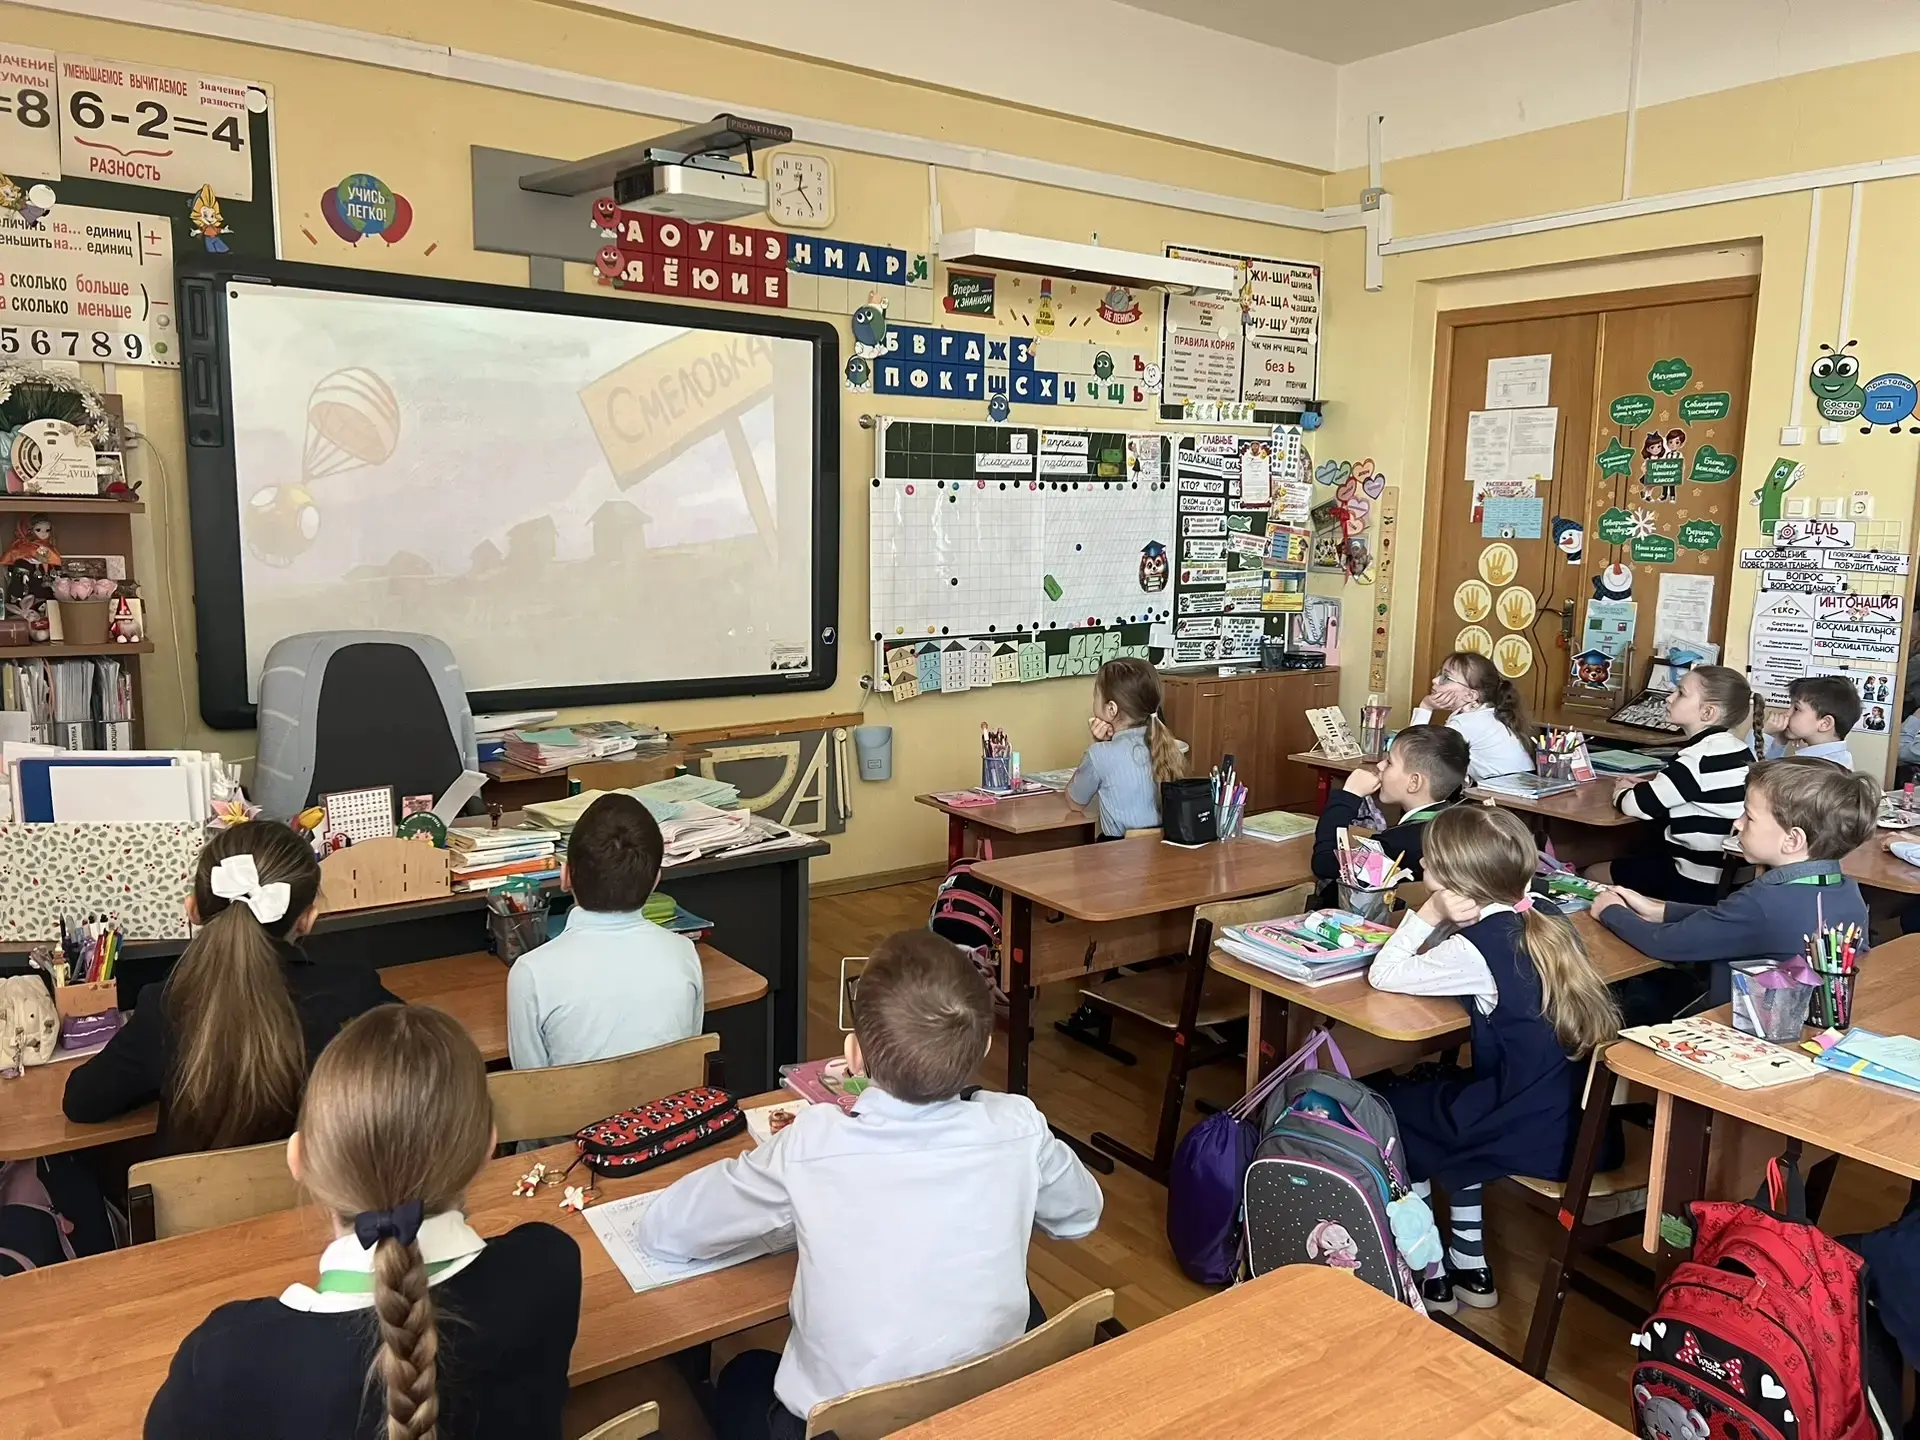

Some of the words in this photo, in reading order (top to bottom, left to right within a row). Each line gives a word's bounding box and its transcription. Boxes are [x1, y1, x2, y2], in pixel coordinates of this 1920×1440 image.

[63, 63, 124, 87] УМЕНЬШАЕМОЕ
[129, 73, 188, 97] ВЫЧИТАЕМОЕ
[198, 80, 246, 97] Значение
[199, 95, 246, 111] разности
[730, 119, 791, 138] PROMETHEAN
[89, 156, 161, 182] РАЗНОСТЬ
[347, 186, 385, 205] УЧИСЬ
[347, 203, 387, 222] ЛЕГКО!
[86, 225, 132, 241] единиц
[87, 241, 133, 258] единиц
[626, 220, 644, 244] А
[660, 224, 681, 247] О
[698, 229, 714, 252] У
[728, 233, 753, 257] Ы
[765, 237, 781, 260] Э
[795, 243, 811, 265] Н
[824, 247, 843, 269] М
[886, 255, 900, 275] Р
[626, 260, 644, 283] Я
[663, 258, 679, 288] Ё
[692, 267, 720, 291] Ю
[731, 272, 749, 295] И
[765, 276, 780, 299] Е
[1250, 269, 1289, 284] ЖИ-ШИ
[1290, 270, 1312, 279] лыжи
[10, 273, 67, 291] сколько
[76, 274, 129, 297] больше
[1291, 281, 1312, 290] шина
[12, 296, 69, 315] сколько
[78, 301, 132, 319] меньше
[1252, 294, 1289, 309] ЧА-ЩА
[1293, 294, 1315, 303] чаща
[1291, 304, 1317, 313] чашка
[1113, 312, 1135, 322] ЛЕНИСЬ
[1251, 317, 1287, 332] ЧУ-ЩУ
[1290, 316, 1313, 325] чулок
[1290, 326, 1309, 336] щука
[1, 327, 20, 353] 5
[31, 329, 51, 355] 6
[61, 331, 79, 356] 7
[91, 331, 112, 357] 8
[124, 334, 143, 359] 9
[885, 332, 899, 351] Б
[912, 334, 926, 354] В
[941, 336, 953, 356] Г
[988, 341, 1007, 361] Ж
[1174, 336, 1209, 348] ПРАВИЛА
[1210, 340, 1235, 351] КОРНЯ
[1265, 359, 1284, 372] без
[607, 337, 773, 443] СМЕЛОВКА
[884, 367, 900, 387] П
[910, 369, 929, 389] Ф
[940, 371, 953, 391] К
[965, 373, 978, 392] Т
[988, 375, 1006, 393] Ш
[1015, 376, 1028, 395] С
[1040, 379, 1052, 397] Х
[1064, 381, 1076, 402] Ц
[1087, 382, 1099, 400] Ч
[1107, 383, 1124, 404] Щ
[1133, 386, 1144, 402] Ь
[1824, 400, 1860, 408] Состав
[1047, 436, 1084, 452] апреля
[1202, 435, 1233, 444] ГЛАВНЫЕ
[978, 454, 1031, 470] Классная
[1179, 452, 1222, 467] ПОДЛЕЖАЩЕЕ
[67, 470, 97, 478] ДУША
[1181, 481, 1200, 490] КТО?
[1204, 483, 1221, 491] ЧТО?
[1805, 524, 1838, 536] ЦЕЛЬ
[1755, 550, 1807, 559] СООБЩЕНИЕ
[1742, 561, 1819, 569] ПОВЕСТВОВАТЕЛЬНОЕ
[1834, 562, 1898, 573] ПОБУДИТЕЛЬНОЕ
[1786, 572, 1823, 582] ВОПРОС
[1770, 582, 1836, 592] ВОПРОСИТЕЛЬНОЕ
[1771, 607, 1800, 616] ТЕКСТ
[1819, 597, 1898, 609] ИНТОНАЦИЯ
[1816, 622, 1896, 636] ВОСКЛИЦАТЕЛЬНОЕ
[1093, 636, 1102, 654] 2
[1815, 640, 1895, 653] НЕВОСКЛИЦАТЕЛЬНОЕ
